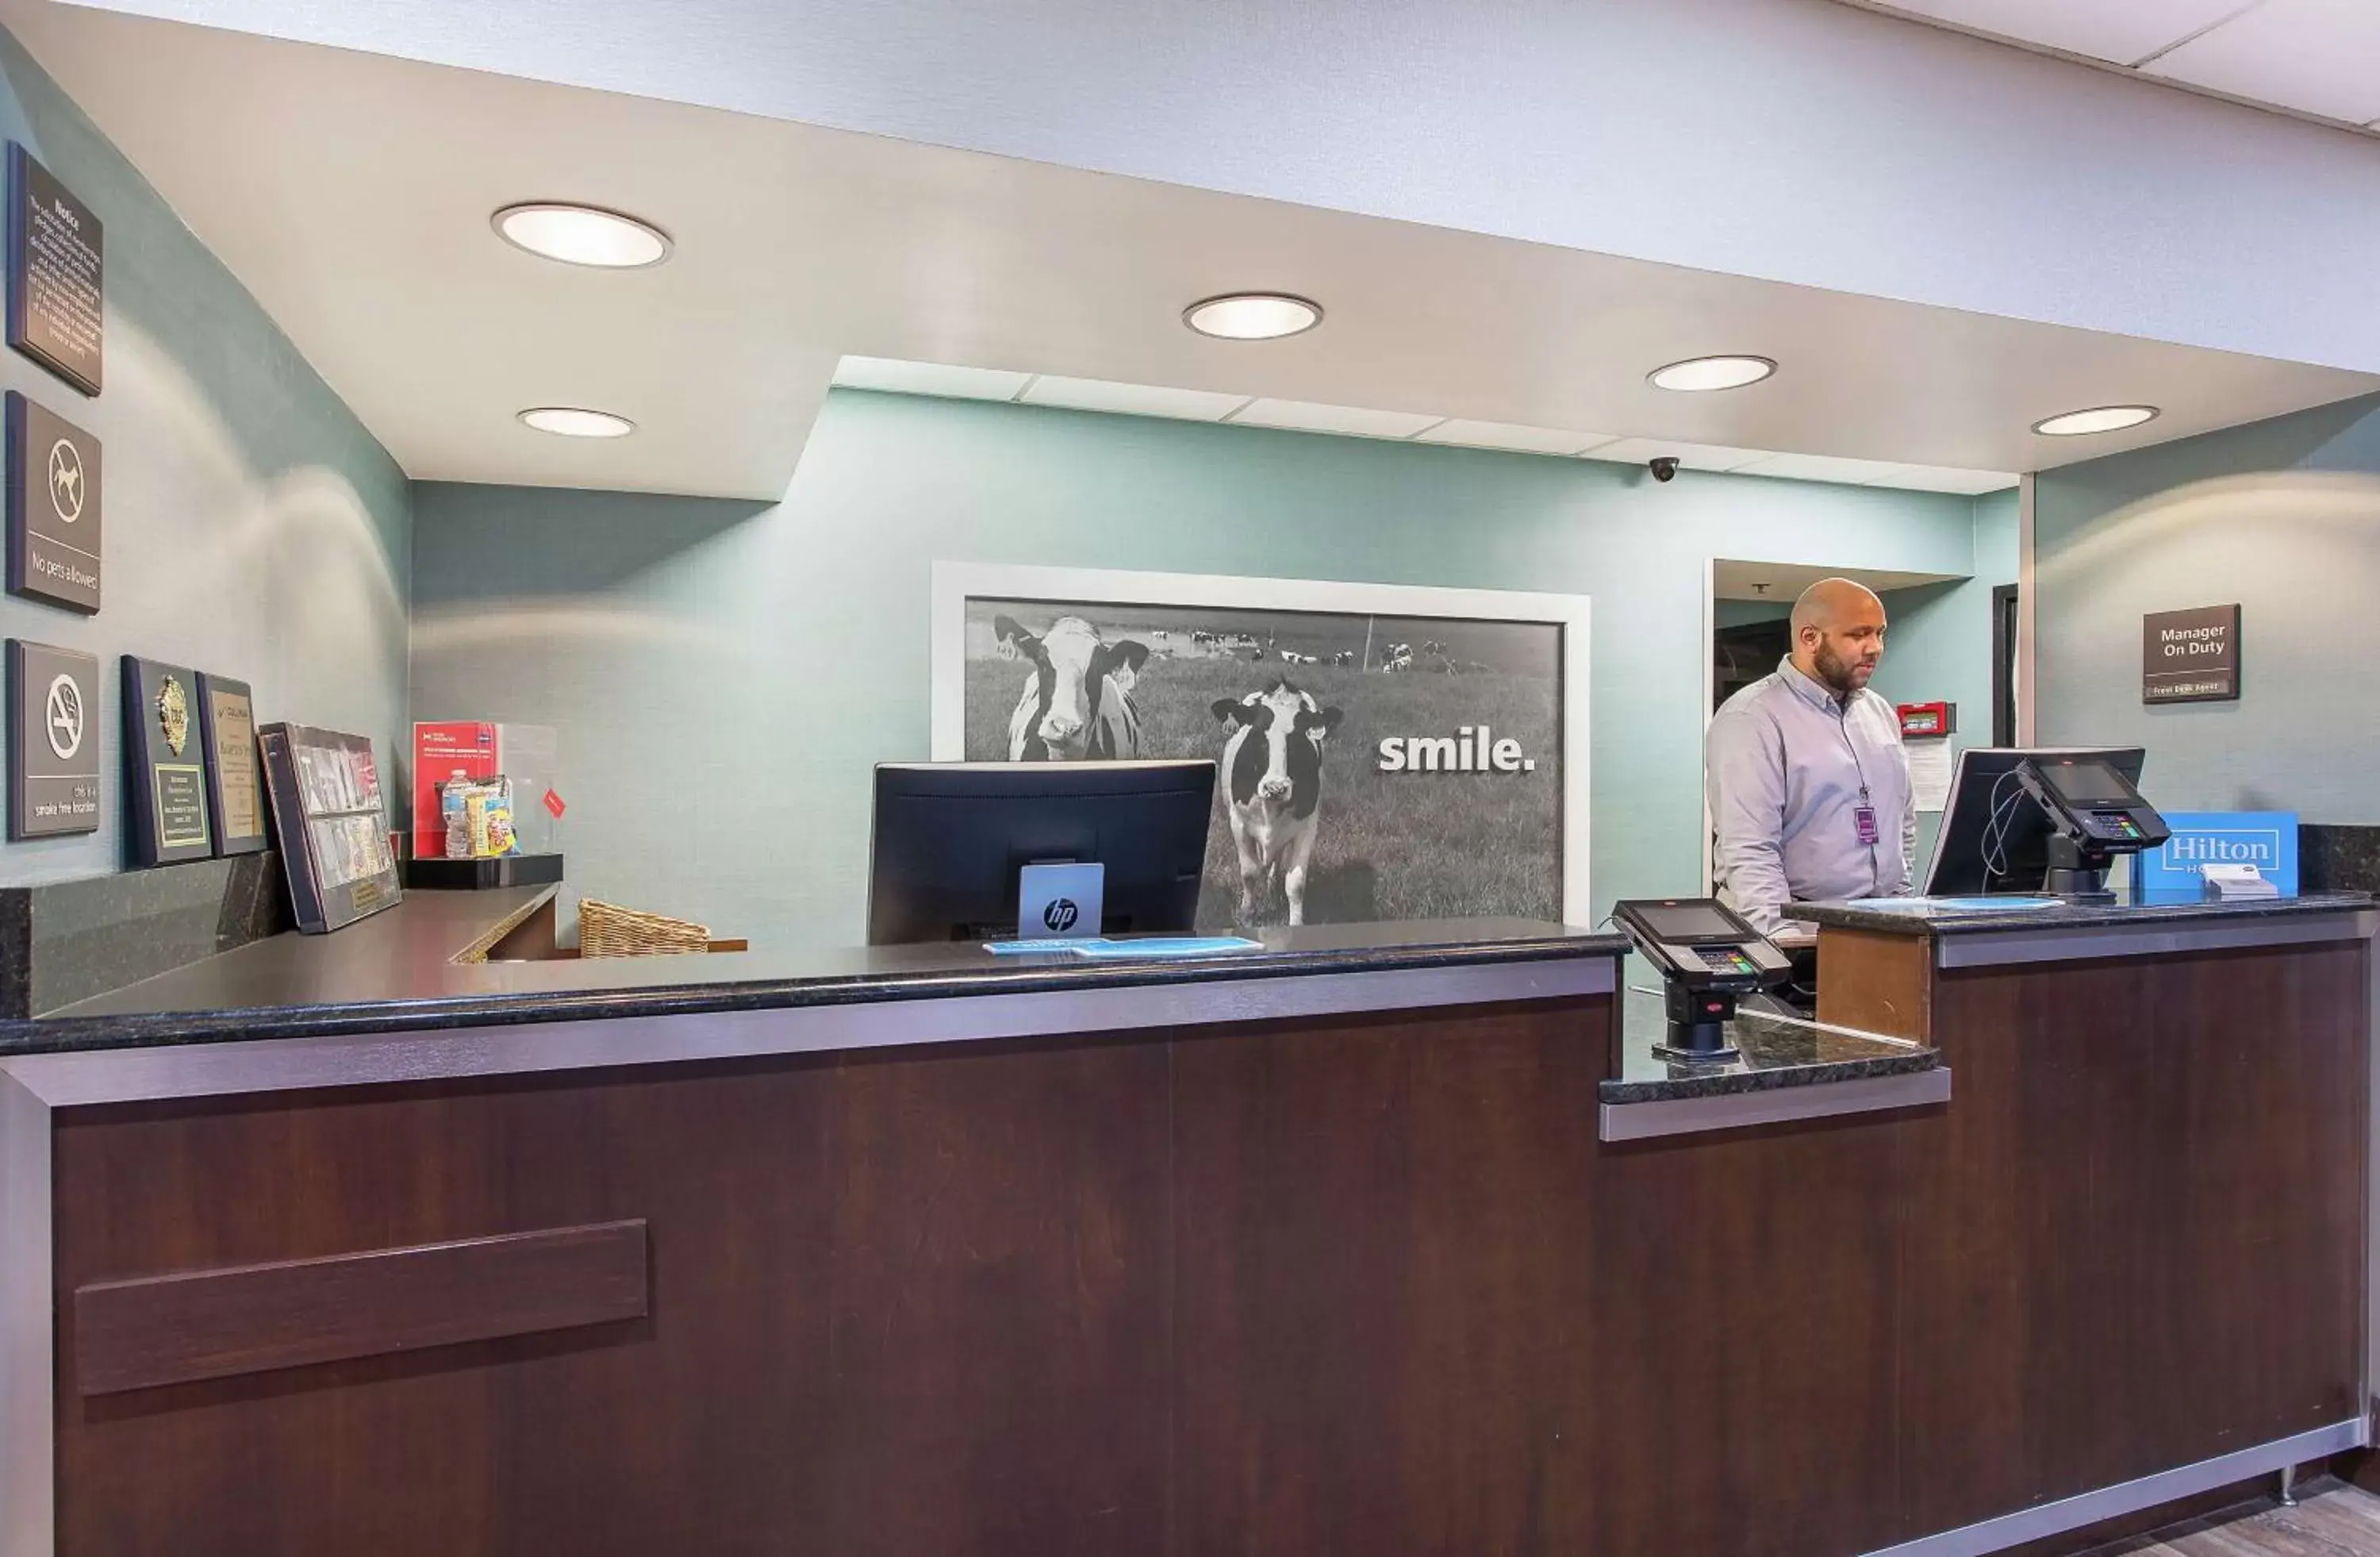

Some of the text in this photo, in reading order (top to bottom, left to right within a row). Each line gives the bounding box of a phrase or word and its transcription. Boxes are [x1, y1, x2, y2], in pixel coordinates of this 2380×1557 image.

[55, 198, 79, 231] Notice
[33, 551, 98, 590] No pets allowed
[2161, 625, 2225, 641] Manager
[2164, 641, 2225, 656] On Duty
[1379, 725, 1535, 771] smile.
[2172, 836, 2271, 860] Hilton
[1047, 898, 1075, 932] hp
